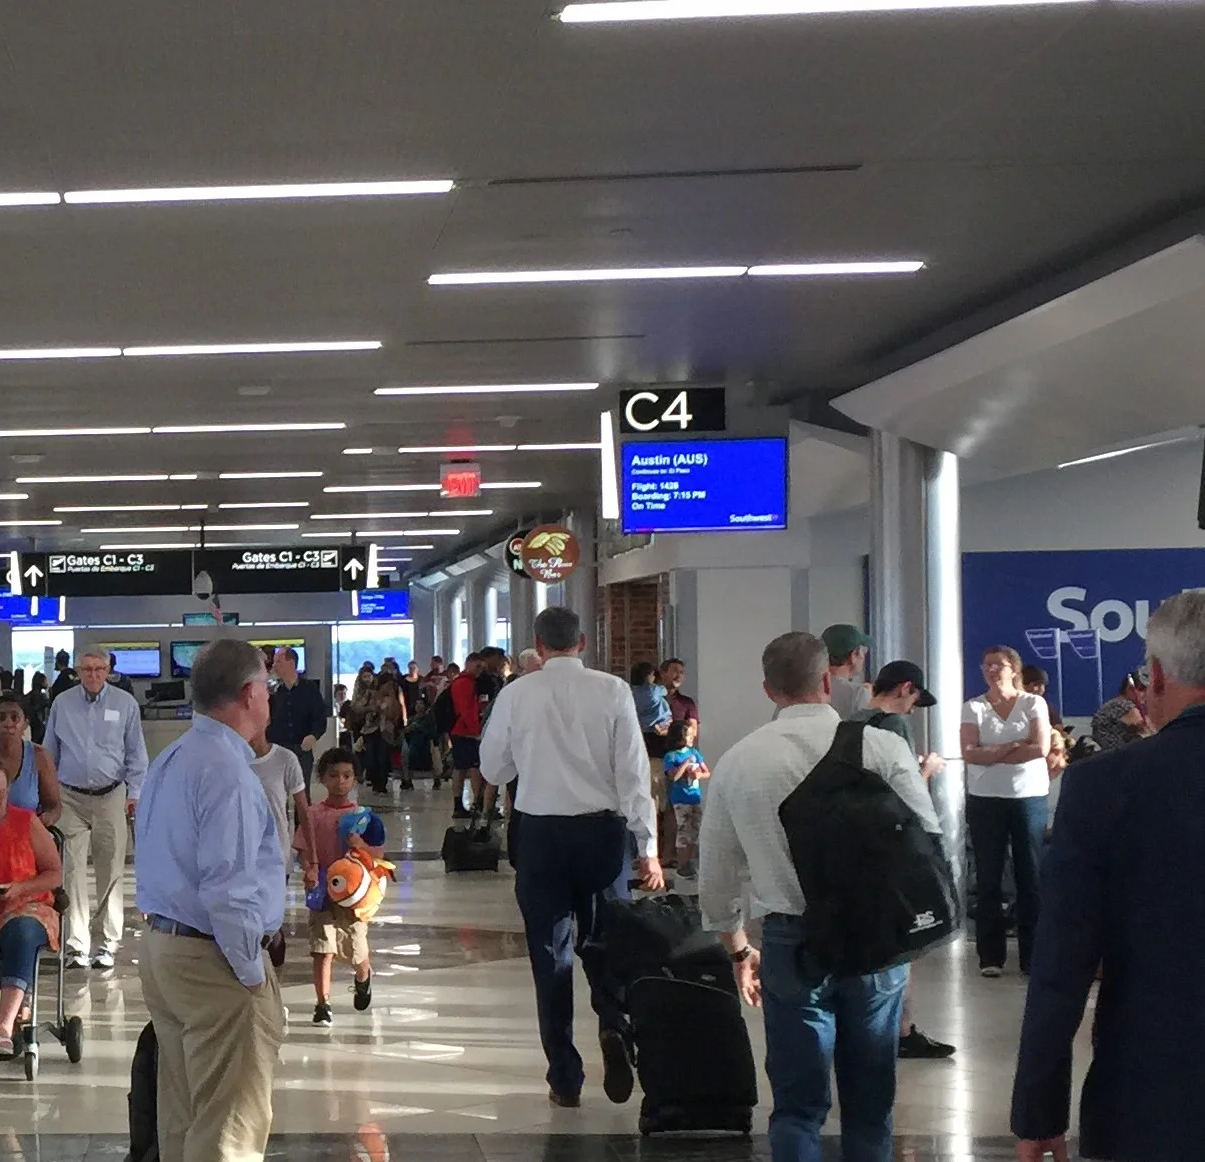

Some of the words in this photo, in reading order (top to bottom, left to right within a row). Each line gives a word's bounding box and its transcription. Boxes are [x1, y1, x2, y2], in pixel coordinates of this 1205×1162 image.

[625, 391, 693, 431] C4
[631, 454, 670, 466] Austin
[673, 453, 708, 467] (AUS)
[692, 491, 706, 499] PM
[631, 502, 644, 510] On
[645, 502, 666, 510] Time
[67, 555, 101, 566] Gates
[102, 554, 116, 565] C1
[127, 554, 144, 565] C3
[242, 552, 276, 563] Gates
[278, 551, 293, 562] C1
[303, 550, 320, 562] C3
